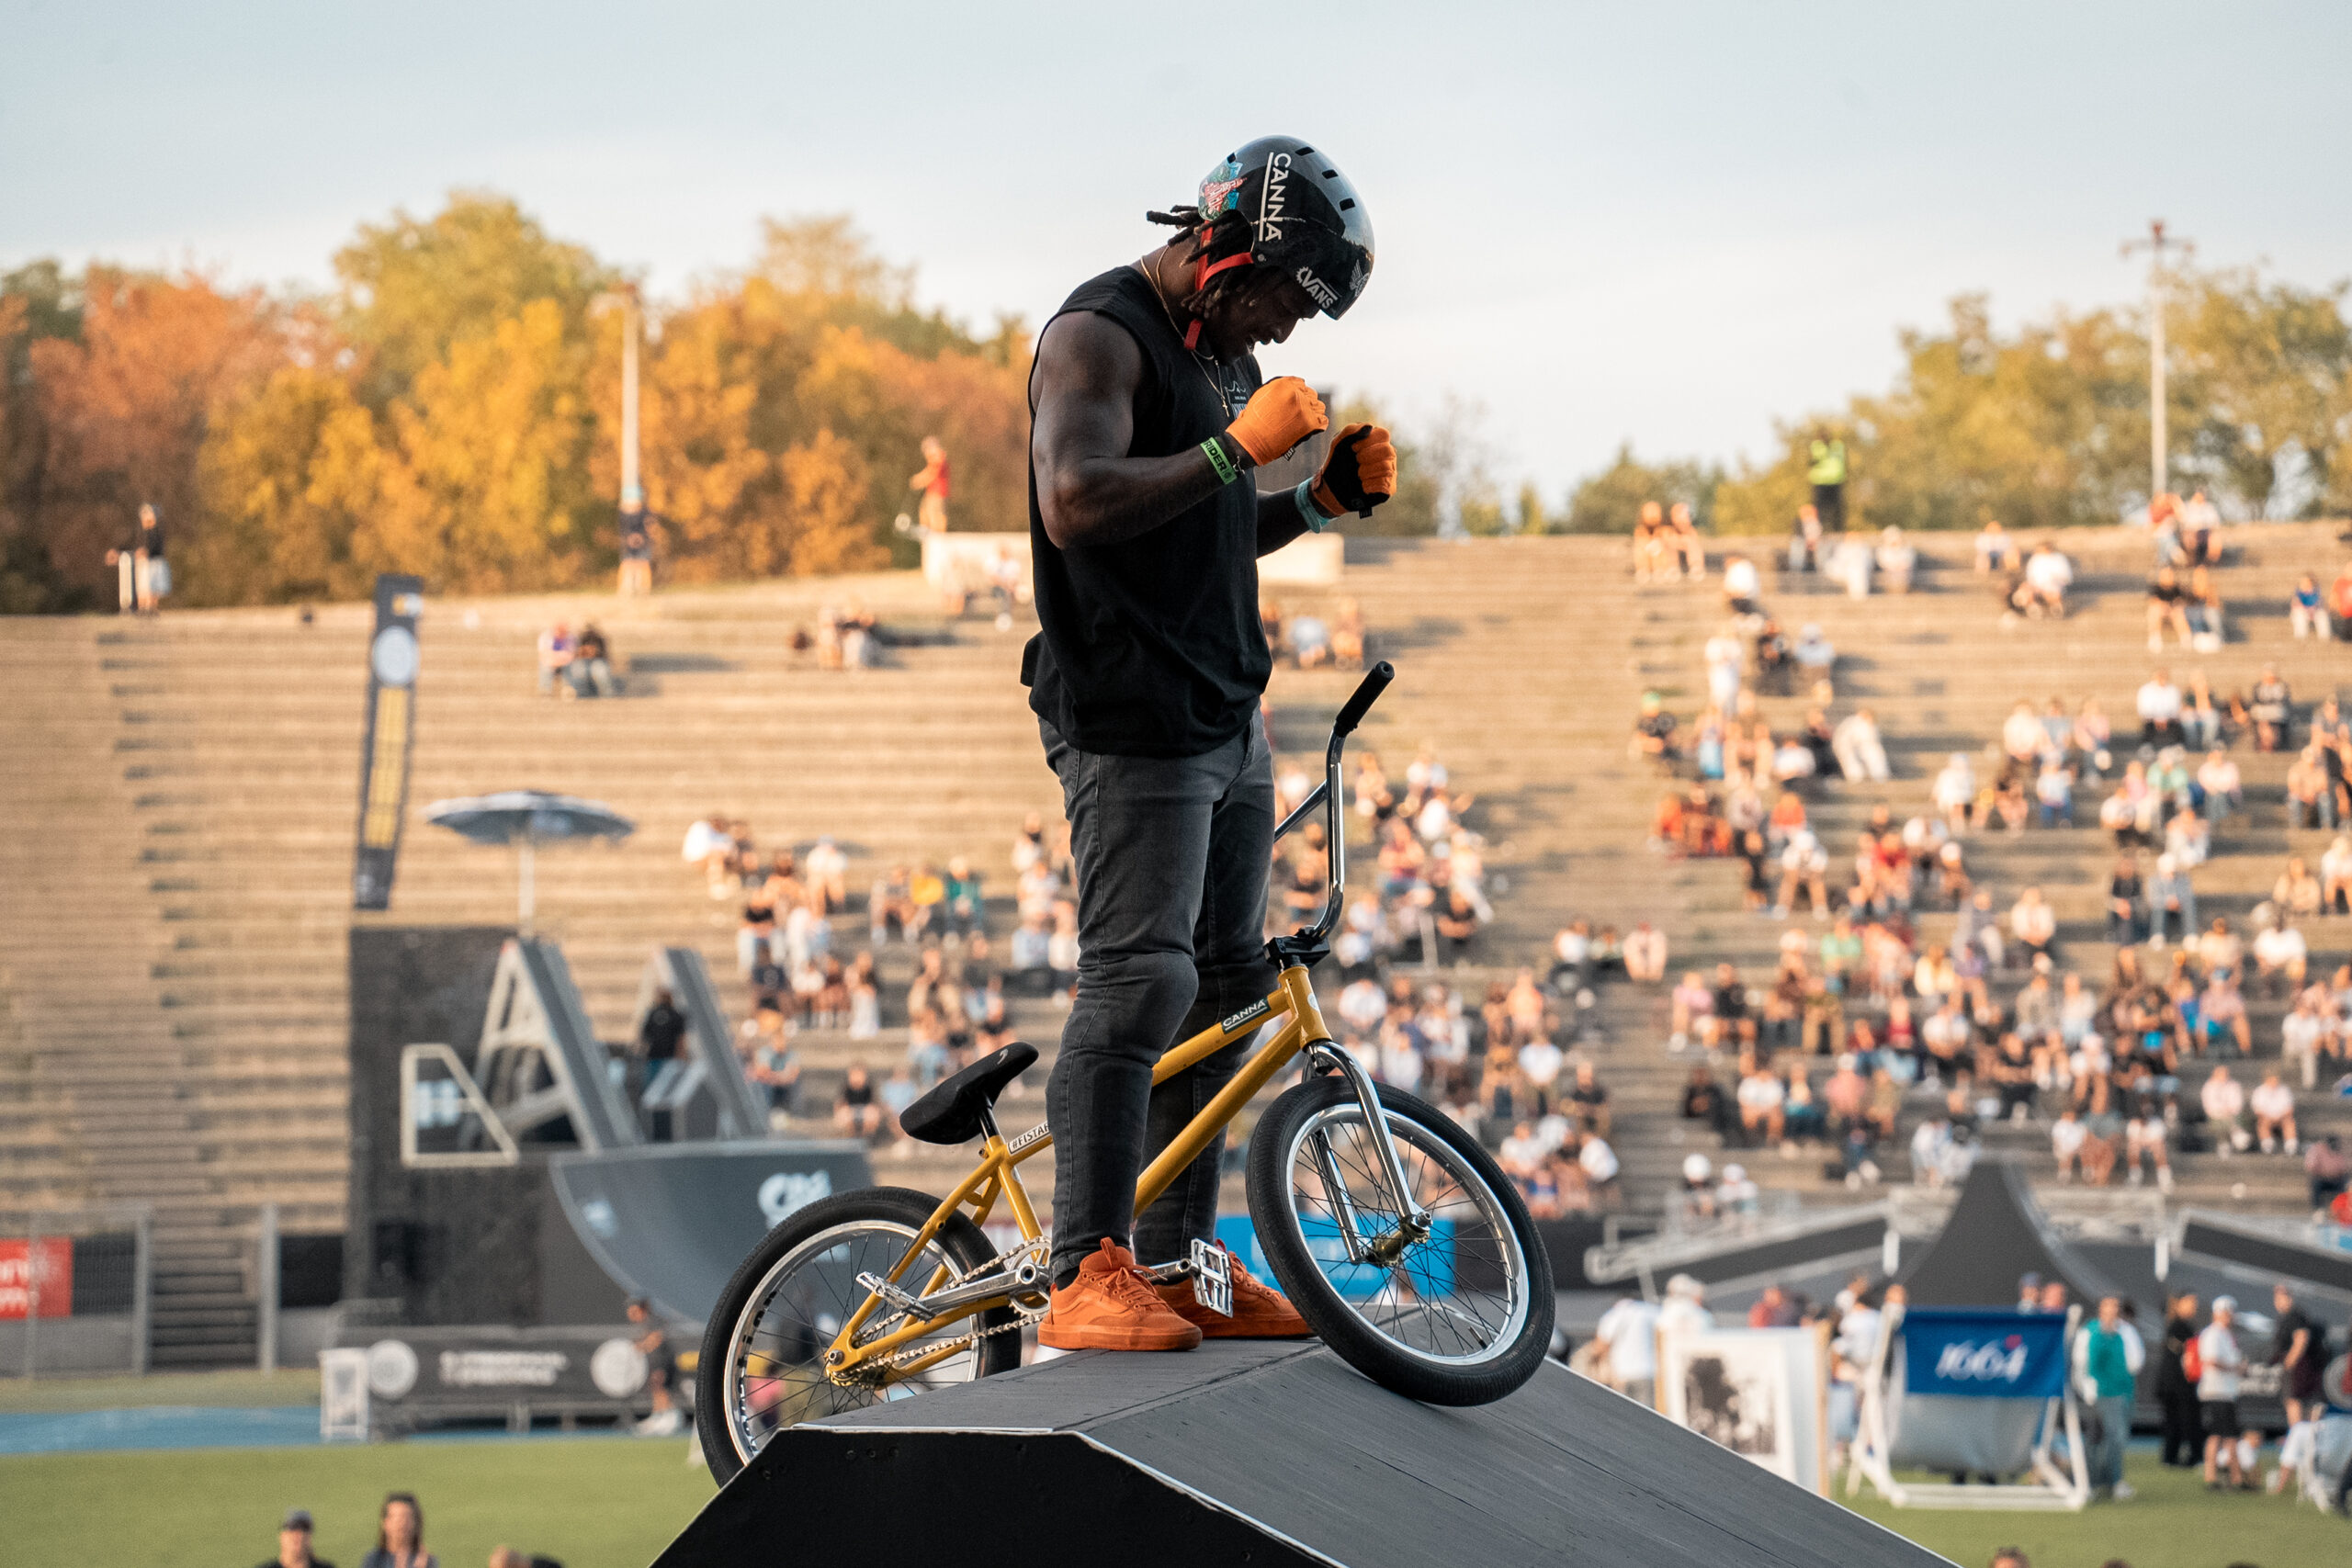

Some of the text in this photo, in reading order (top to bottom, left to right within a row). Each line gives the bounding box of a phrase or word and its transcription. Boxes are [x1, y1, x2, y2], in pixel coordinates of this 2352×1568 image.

[1264, 152, 1292, 242] CANNA
[1301, 269, 1339, 309] VANS
[1204, 441, 1227, 470] RIDER
[1222, 998, 1266, 1027] CANNA
